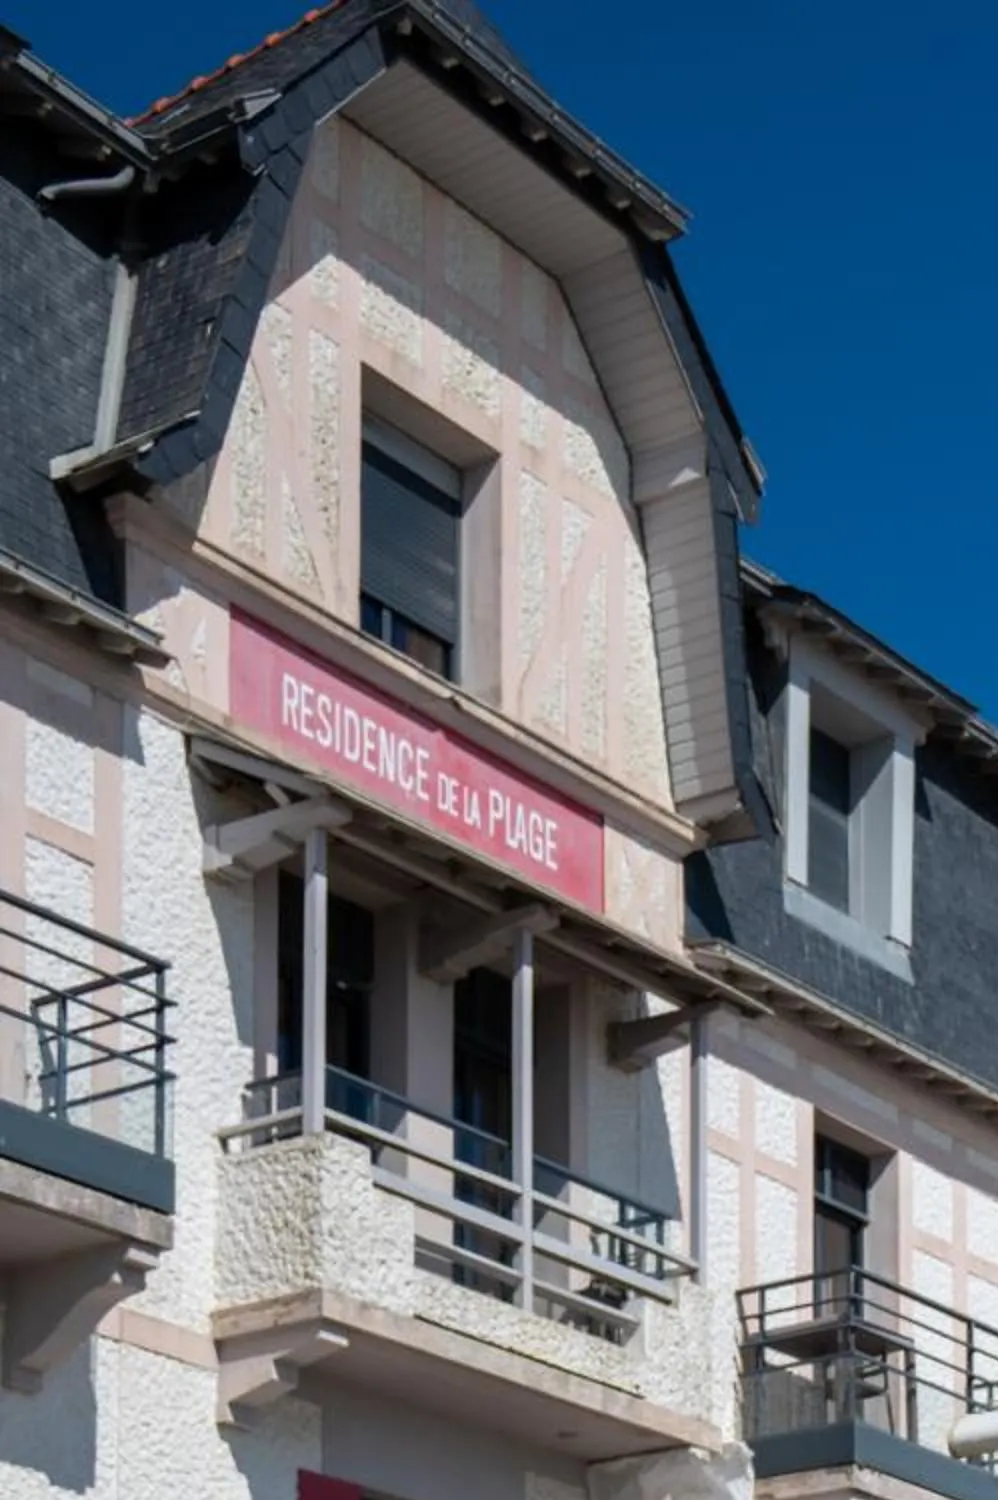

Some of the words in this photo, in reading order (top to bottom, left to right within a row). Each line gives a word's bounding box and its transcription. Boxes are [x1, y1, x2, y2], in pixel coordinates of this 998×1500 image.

[280, 672, 431, 803] RESIDENCE
[437, 772, 459, 817] DE
[463, 786, 481, 830] LA
[488, 789, 559, 871] PLAGE
